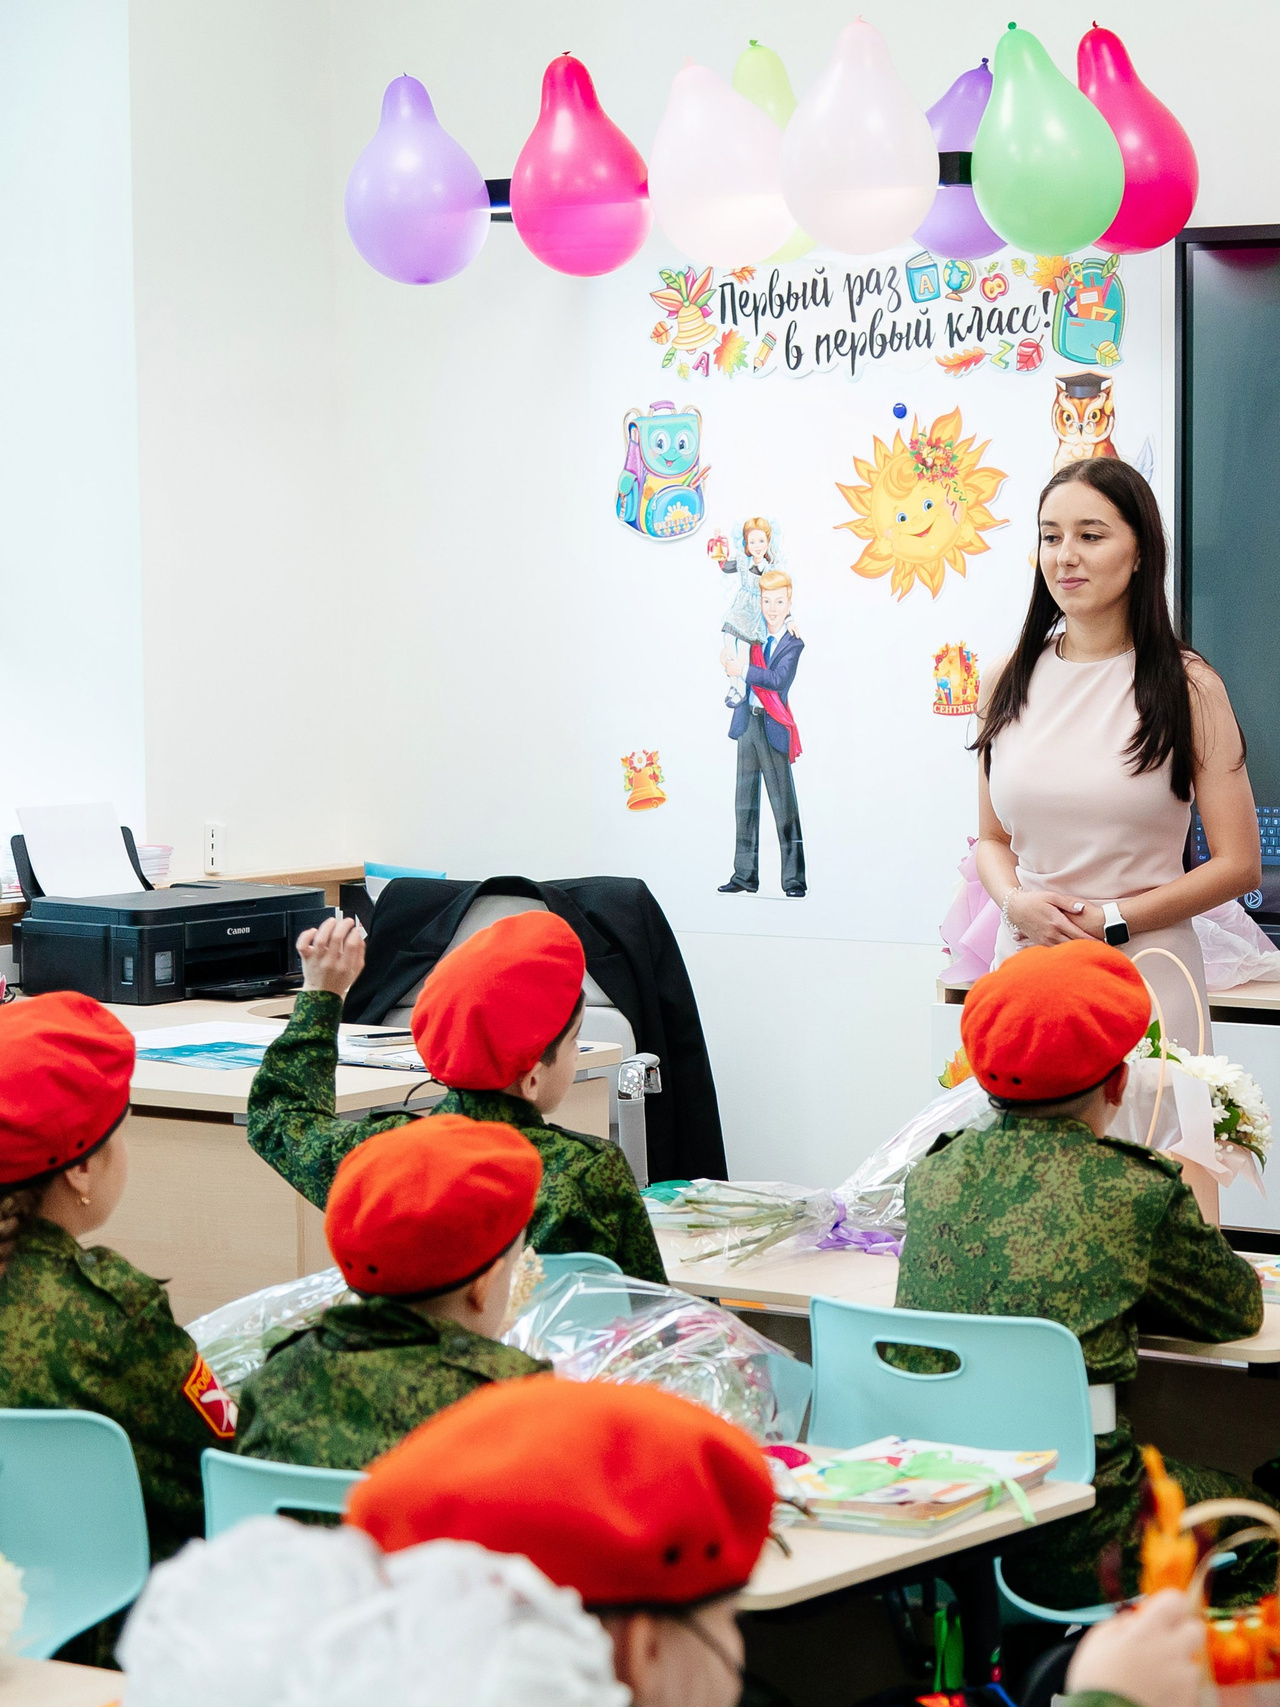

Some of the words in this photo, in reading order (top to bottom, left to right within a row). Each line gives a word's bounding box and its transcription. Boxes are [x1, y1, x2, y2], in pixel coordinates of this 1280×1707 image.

[718, 266, 834, 337] Первый
[843, 265, 902, 323] раз
[784, 319, 805, 371] в
[815, 307, 937, 377] первый
[944, 290, 1053, 348] класс!
[226, 926, 251, 936] Canon
